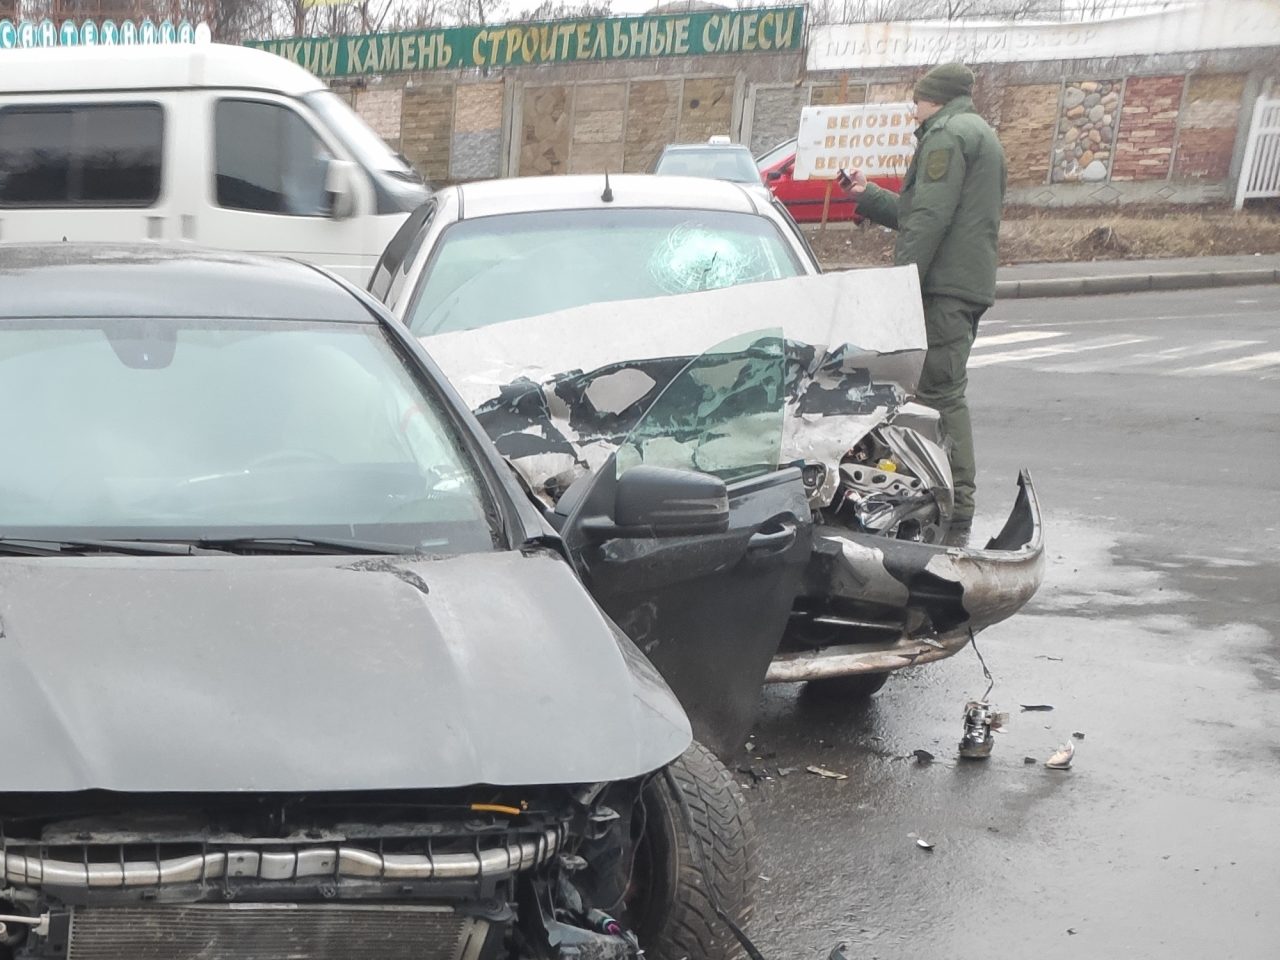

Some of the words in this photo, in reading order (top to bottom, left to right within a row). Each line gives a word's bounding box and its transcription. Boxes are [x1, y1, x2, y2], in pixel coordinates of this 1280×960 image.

[1, 21, 193, 48] САНТЕХНИКА
[472, 16, 691, 66] СТРОИТЕЛЬНЫЕ
[702, 11, 796, 52] СМЕСИ
[824, 132, 913, 150] ВЕЛОСВЕ
